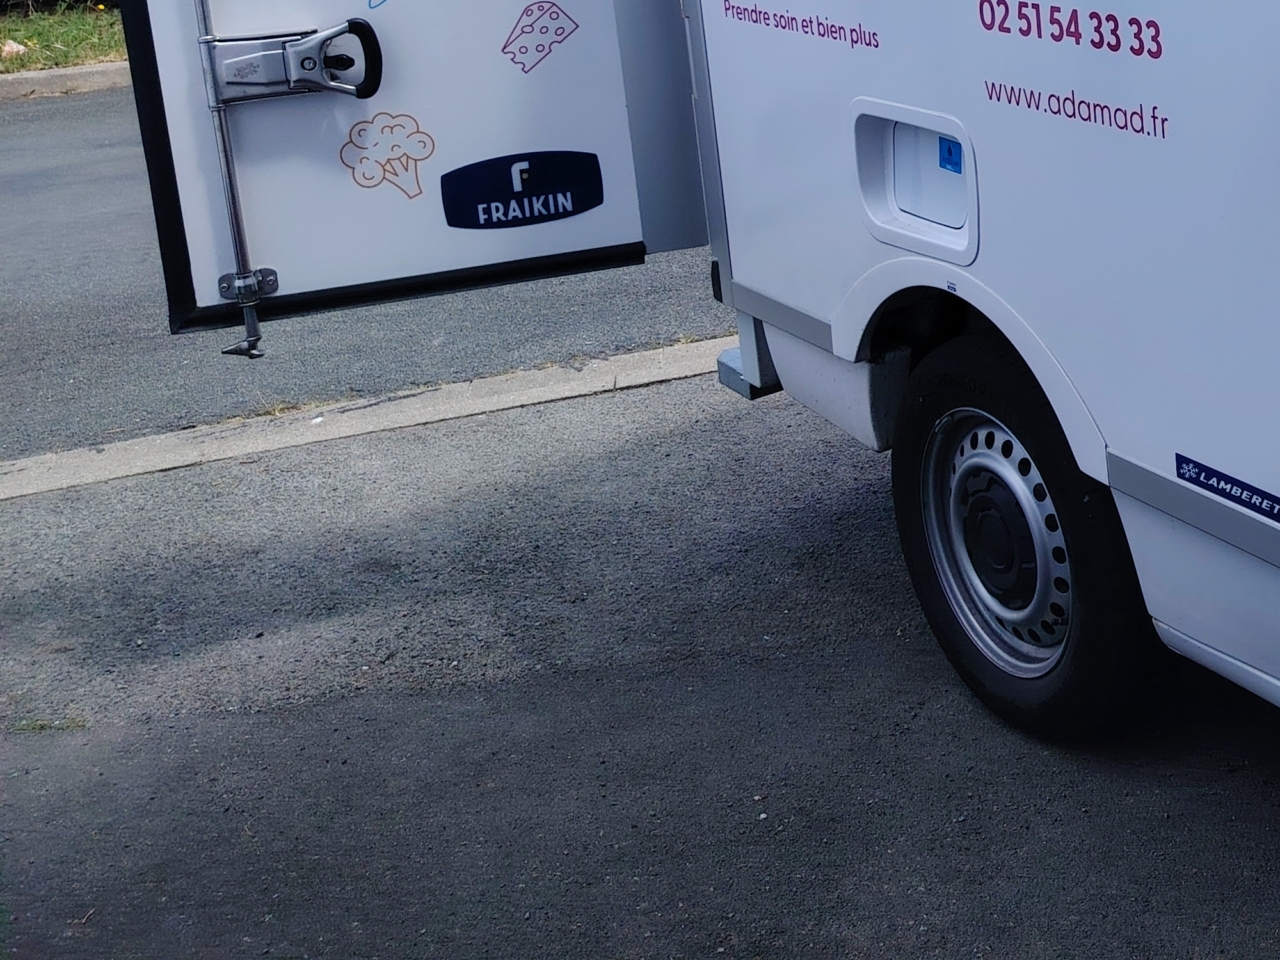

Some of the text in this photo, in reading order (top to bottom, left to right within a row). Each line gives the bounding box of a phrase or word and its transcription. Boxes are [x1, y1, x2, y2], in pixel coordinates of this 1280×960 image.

[773, 9, 798, 31] soin
[802, 17, 814, 35] et
[817, 16, 847, 42] bien
[850, 23, 879, 48] plus
[1018, 1, 1042, 38] 51
[1050, 6, 1082, 45] 54
[1089, 12, 1121, 52] 33
[1128, 18, 1162, 59] 33
[985, 81, 1168, 138] www.adamad.fr
[478, 192, 572, 224] FRAIKIN
